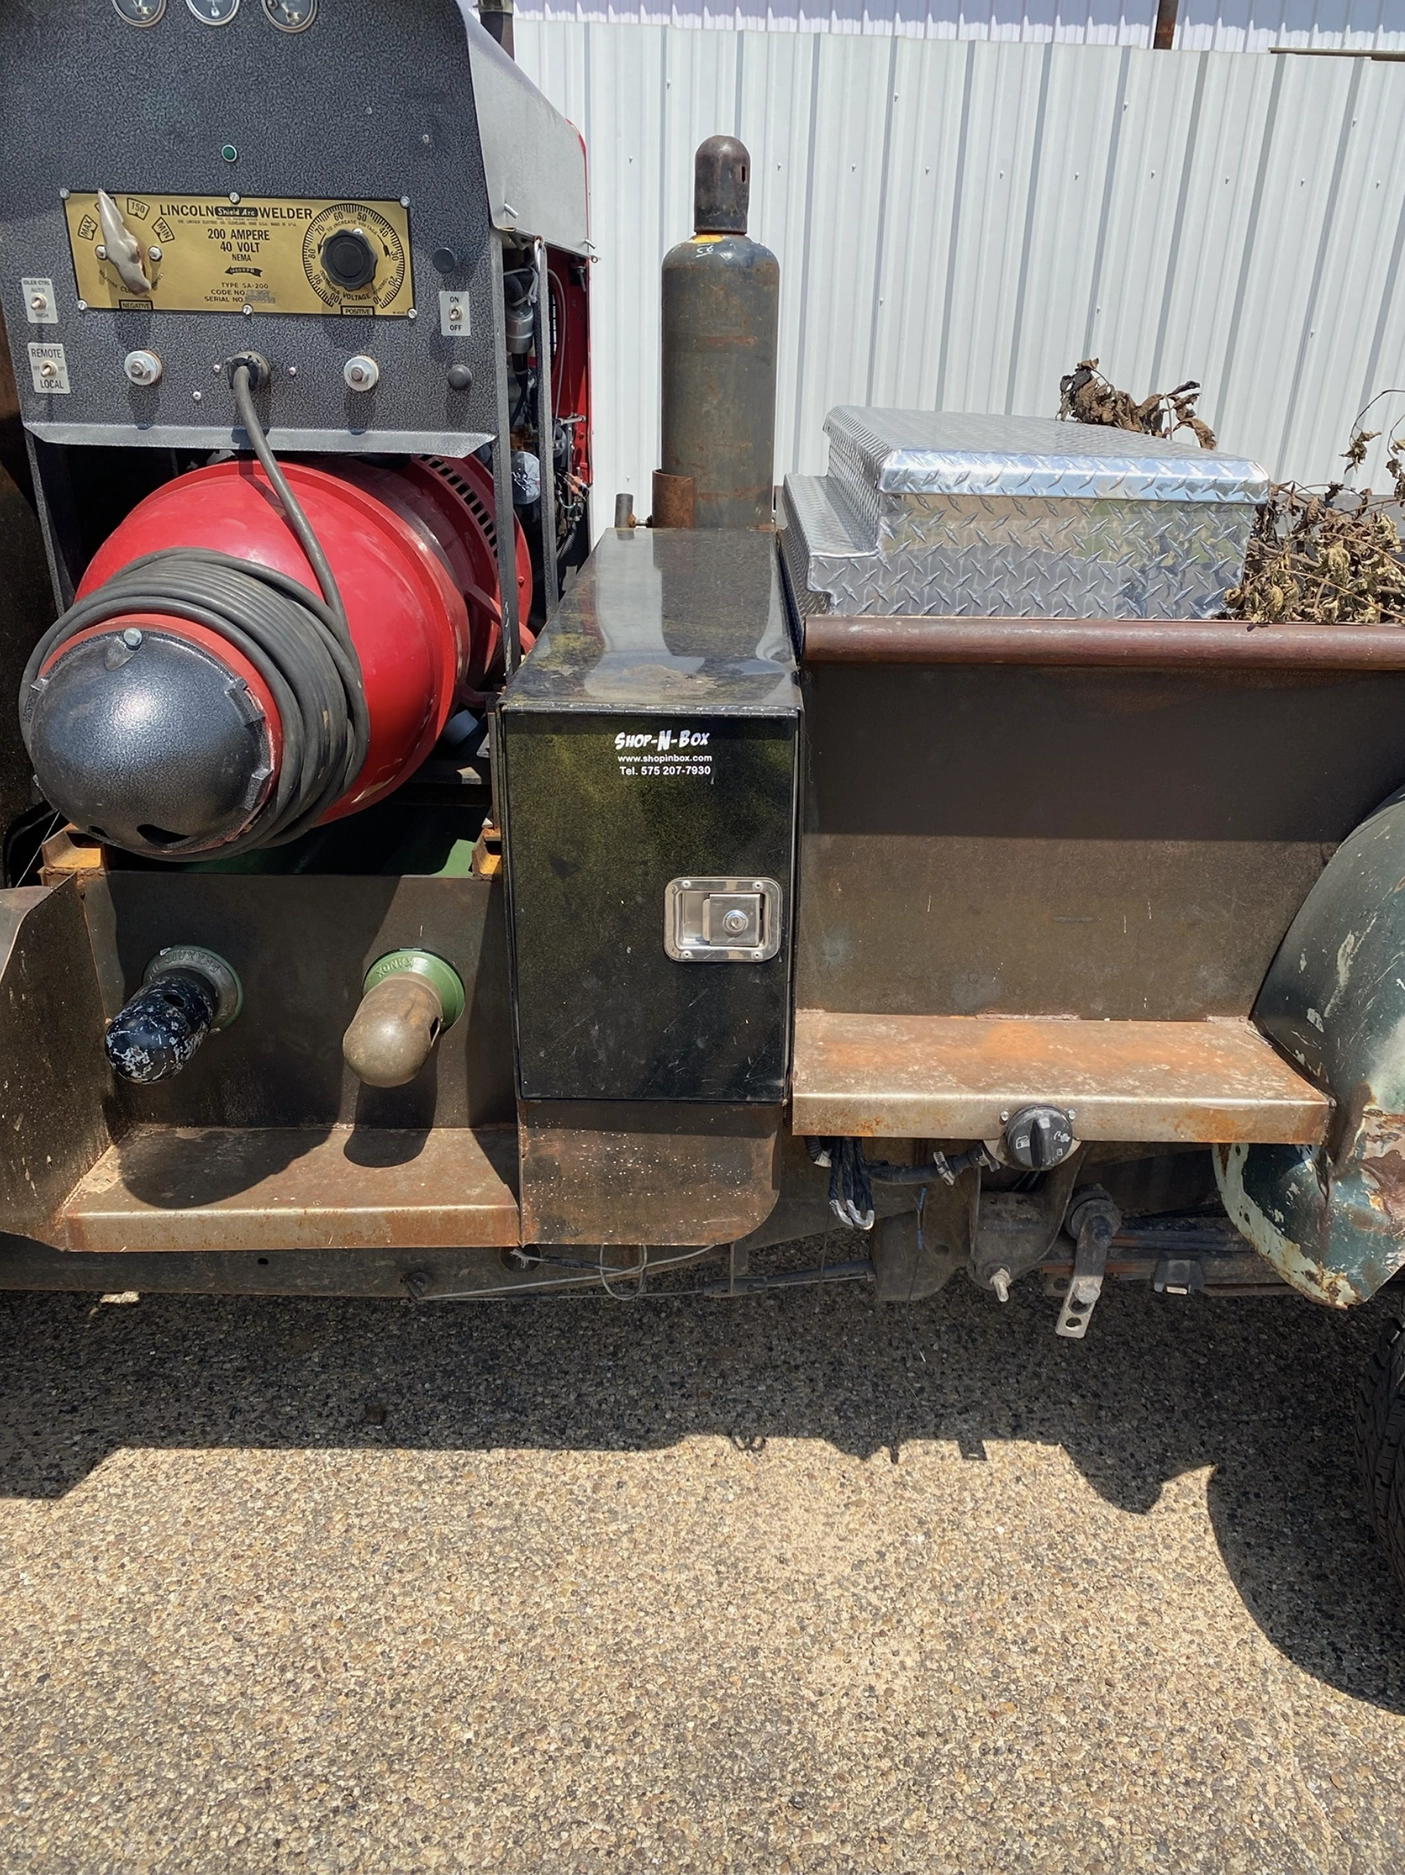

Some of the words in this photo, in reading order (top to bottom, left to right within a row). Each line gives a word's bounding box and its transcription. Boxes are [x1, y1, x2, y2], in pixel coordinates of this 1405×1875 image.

[131, 202, 146, 213] 150
[159, 204, 214, 217] LINCOLN
[217, 207, 240, 216] Shield
[241, 208, 256, 216] Arc
[258, 206, 313, 219] WELDER
[334, 211, 344, 221] 60
[356, 212, 367, 222] 50
[80, 219, 93, 238] MAX
[333, 219, 357, 228] INCREASE
[157, 220, 172, 239] MIN
[207, 228, 226, 240] 200
[230, 229, 270, 241] AMPERE
[314, 224, 325, 236] 70
[379, 227, 389, 238] 40
[220, 241, 233, 252] 40
[236, 241, 260, 253] VOLT
[231, 253, 252, 262] NEMA
[307, 248, 316, 259] 80
[390, 250, 399, 261] 30
[313, 273, 323, 285] 90
[388, 275, 398, 286] 20
[329, 292, 343, 305] 100
[343, 292, 372, 301] VOLTAGE
[372, 295, 382, 305] 10
[122, 302, 151, 310] NEGATIVE
[31, 348, 62, 359] REMOTE
[40, 379, 64, 389] LOCAL
[617, 754, 713, 764] www.shopinbox.com
[619, 766, 639, 775] Tel.
[641, 766, 660, 775] 575
[662, 766, 711, 775] 207-7930
